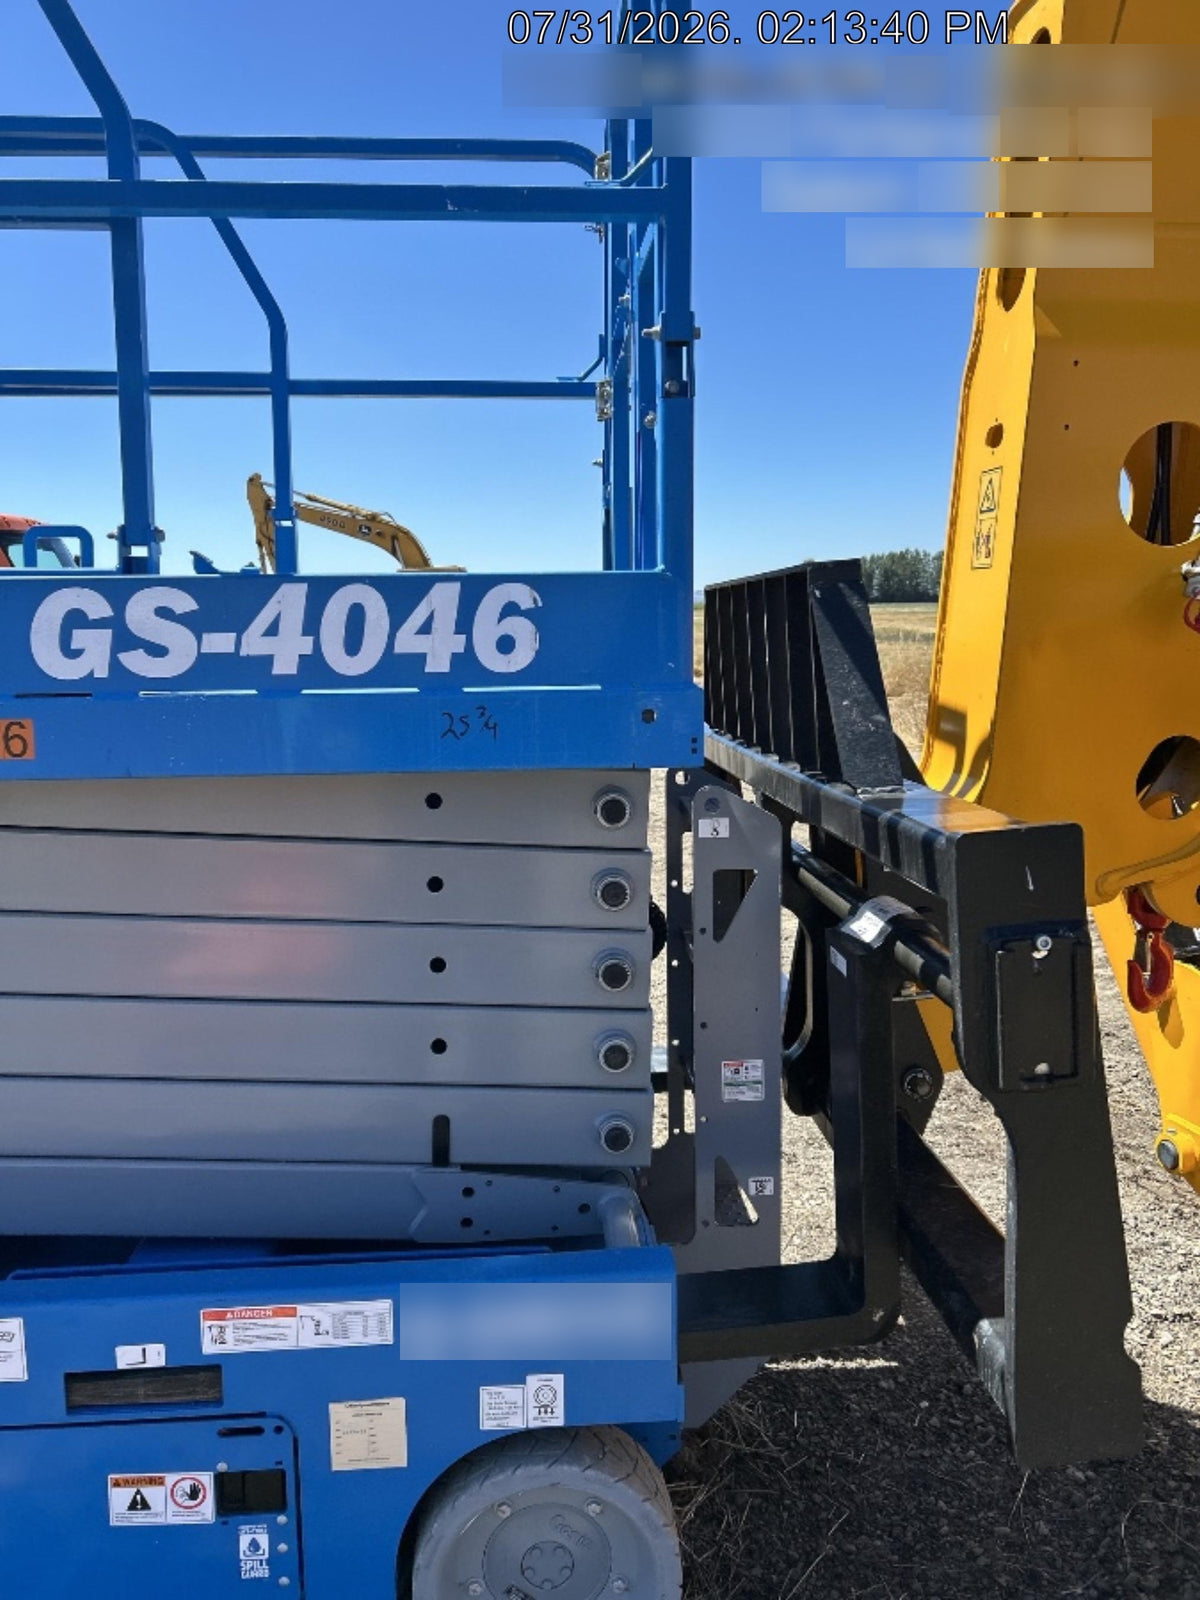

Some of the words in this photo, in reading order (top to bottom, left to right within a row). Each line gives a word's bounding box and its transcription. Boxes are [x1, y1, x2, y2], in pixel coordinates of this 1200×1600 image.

[29, 581, 543, 680] GS-4046
[441, 711, 470, 740] 25
[233, 1309, 273, 1319] DANGER
[123, 1475, 165, 1487] WARNING
[240, 1560, 269, 1570] SPILL
